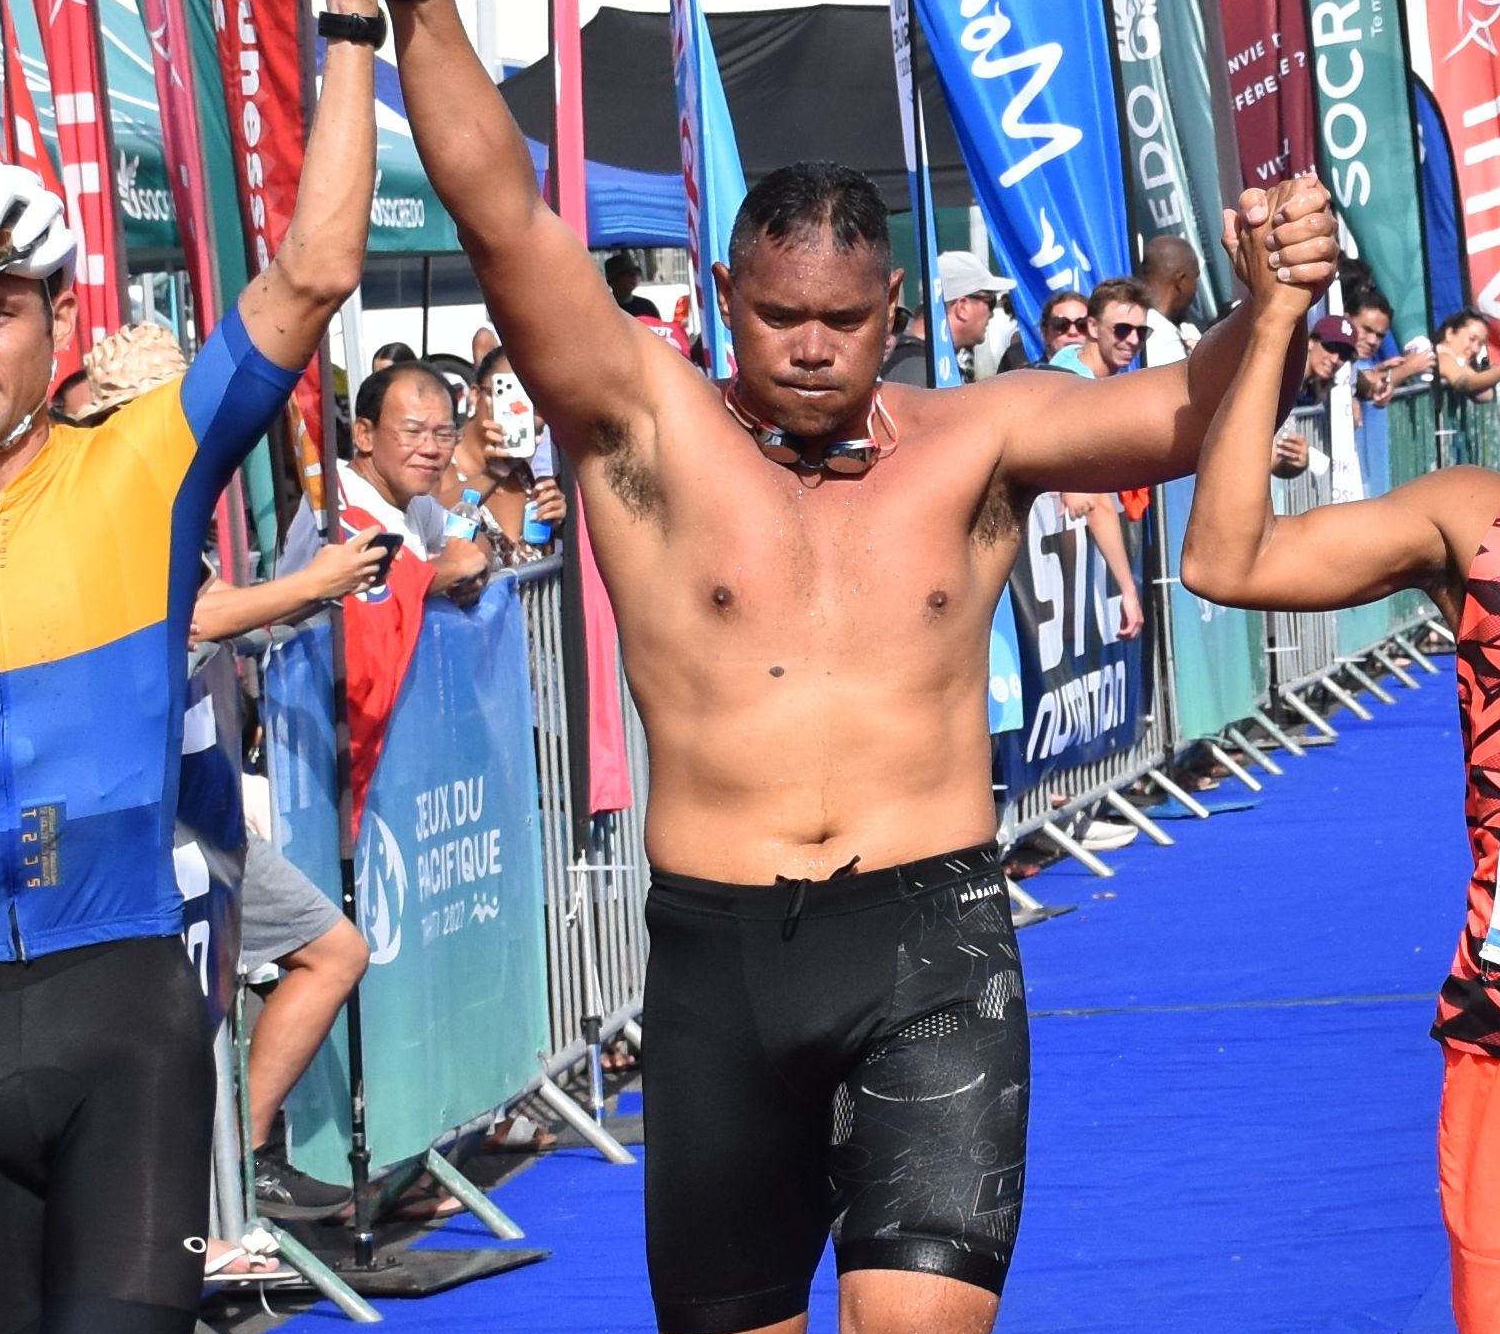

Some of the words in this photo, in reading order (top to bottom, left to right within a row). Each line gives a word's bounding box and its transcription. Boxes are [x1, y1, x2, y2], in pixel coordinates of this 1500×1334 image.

[1370, 15, 1383, 39] Te
[1227, 40, 1266, 75] NVIE
[416, 784, 451, 843] JEUX
[454, 775, 484, 827] DU
[417, 828, 503, 903] PACIFIQUE
